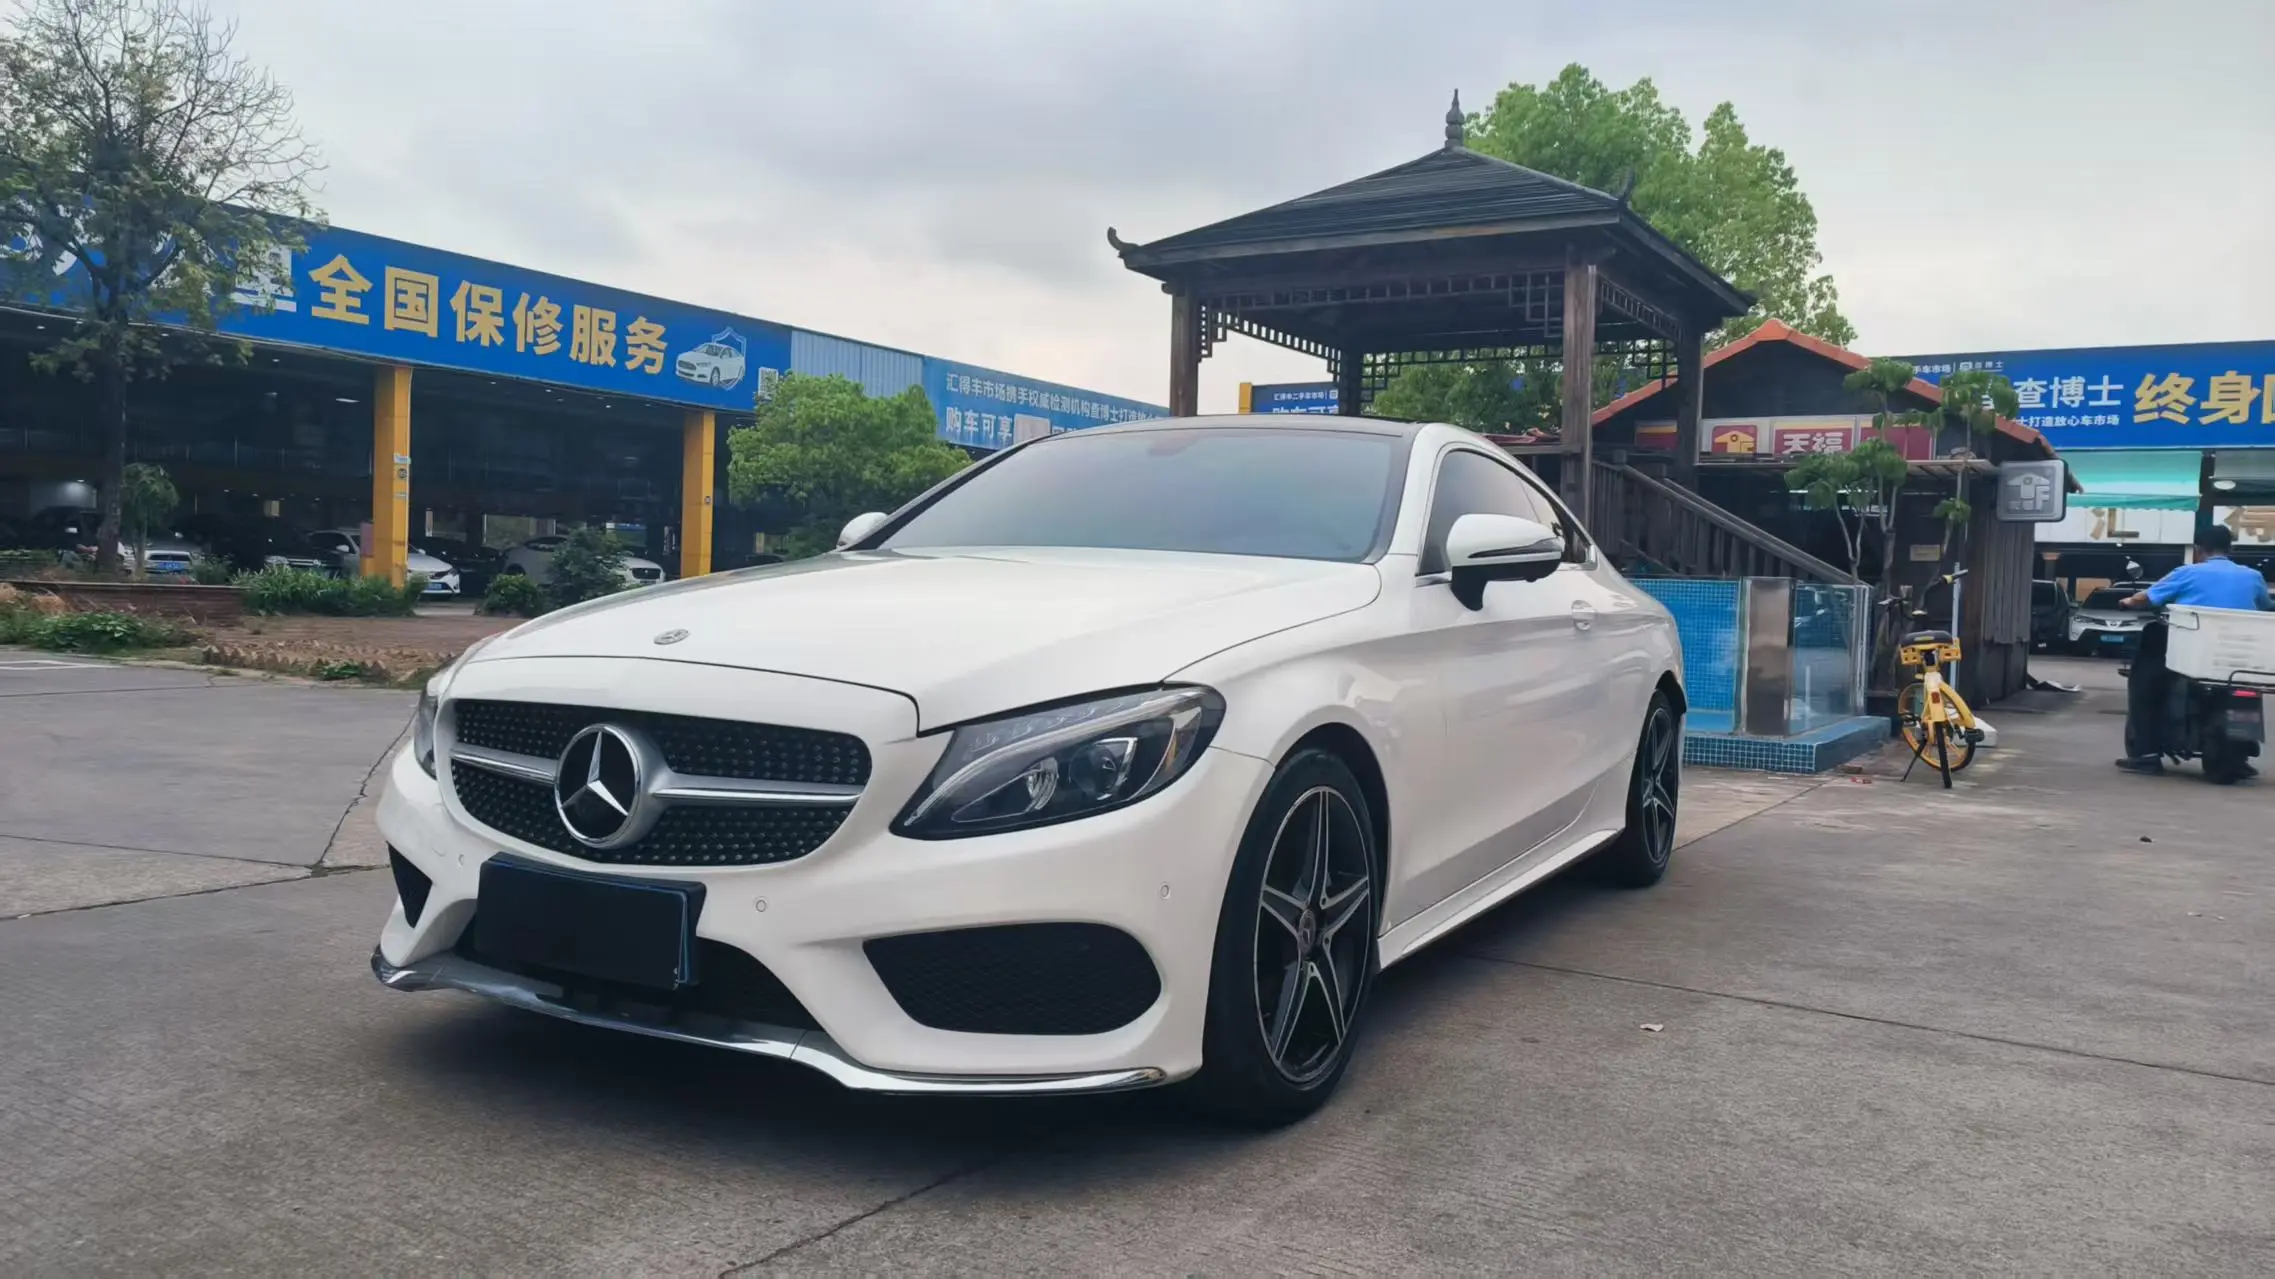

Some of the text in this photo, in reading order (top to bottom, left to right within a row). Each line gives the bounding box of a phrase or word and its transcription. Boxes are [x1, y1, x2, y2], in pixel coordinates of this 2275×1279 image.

[308, 254, 668, 374] 全国保修服务
[2013, 375, 2124, 409] 查博士
[2134, 370, 2275, 424] 终身
[946, 406, 1013, 447] 购车可享
[1782, 432, 1844, 454] 天福
